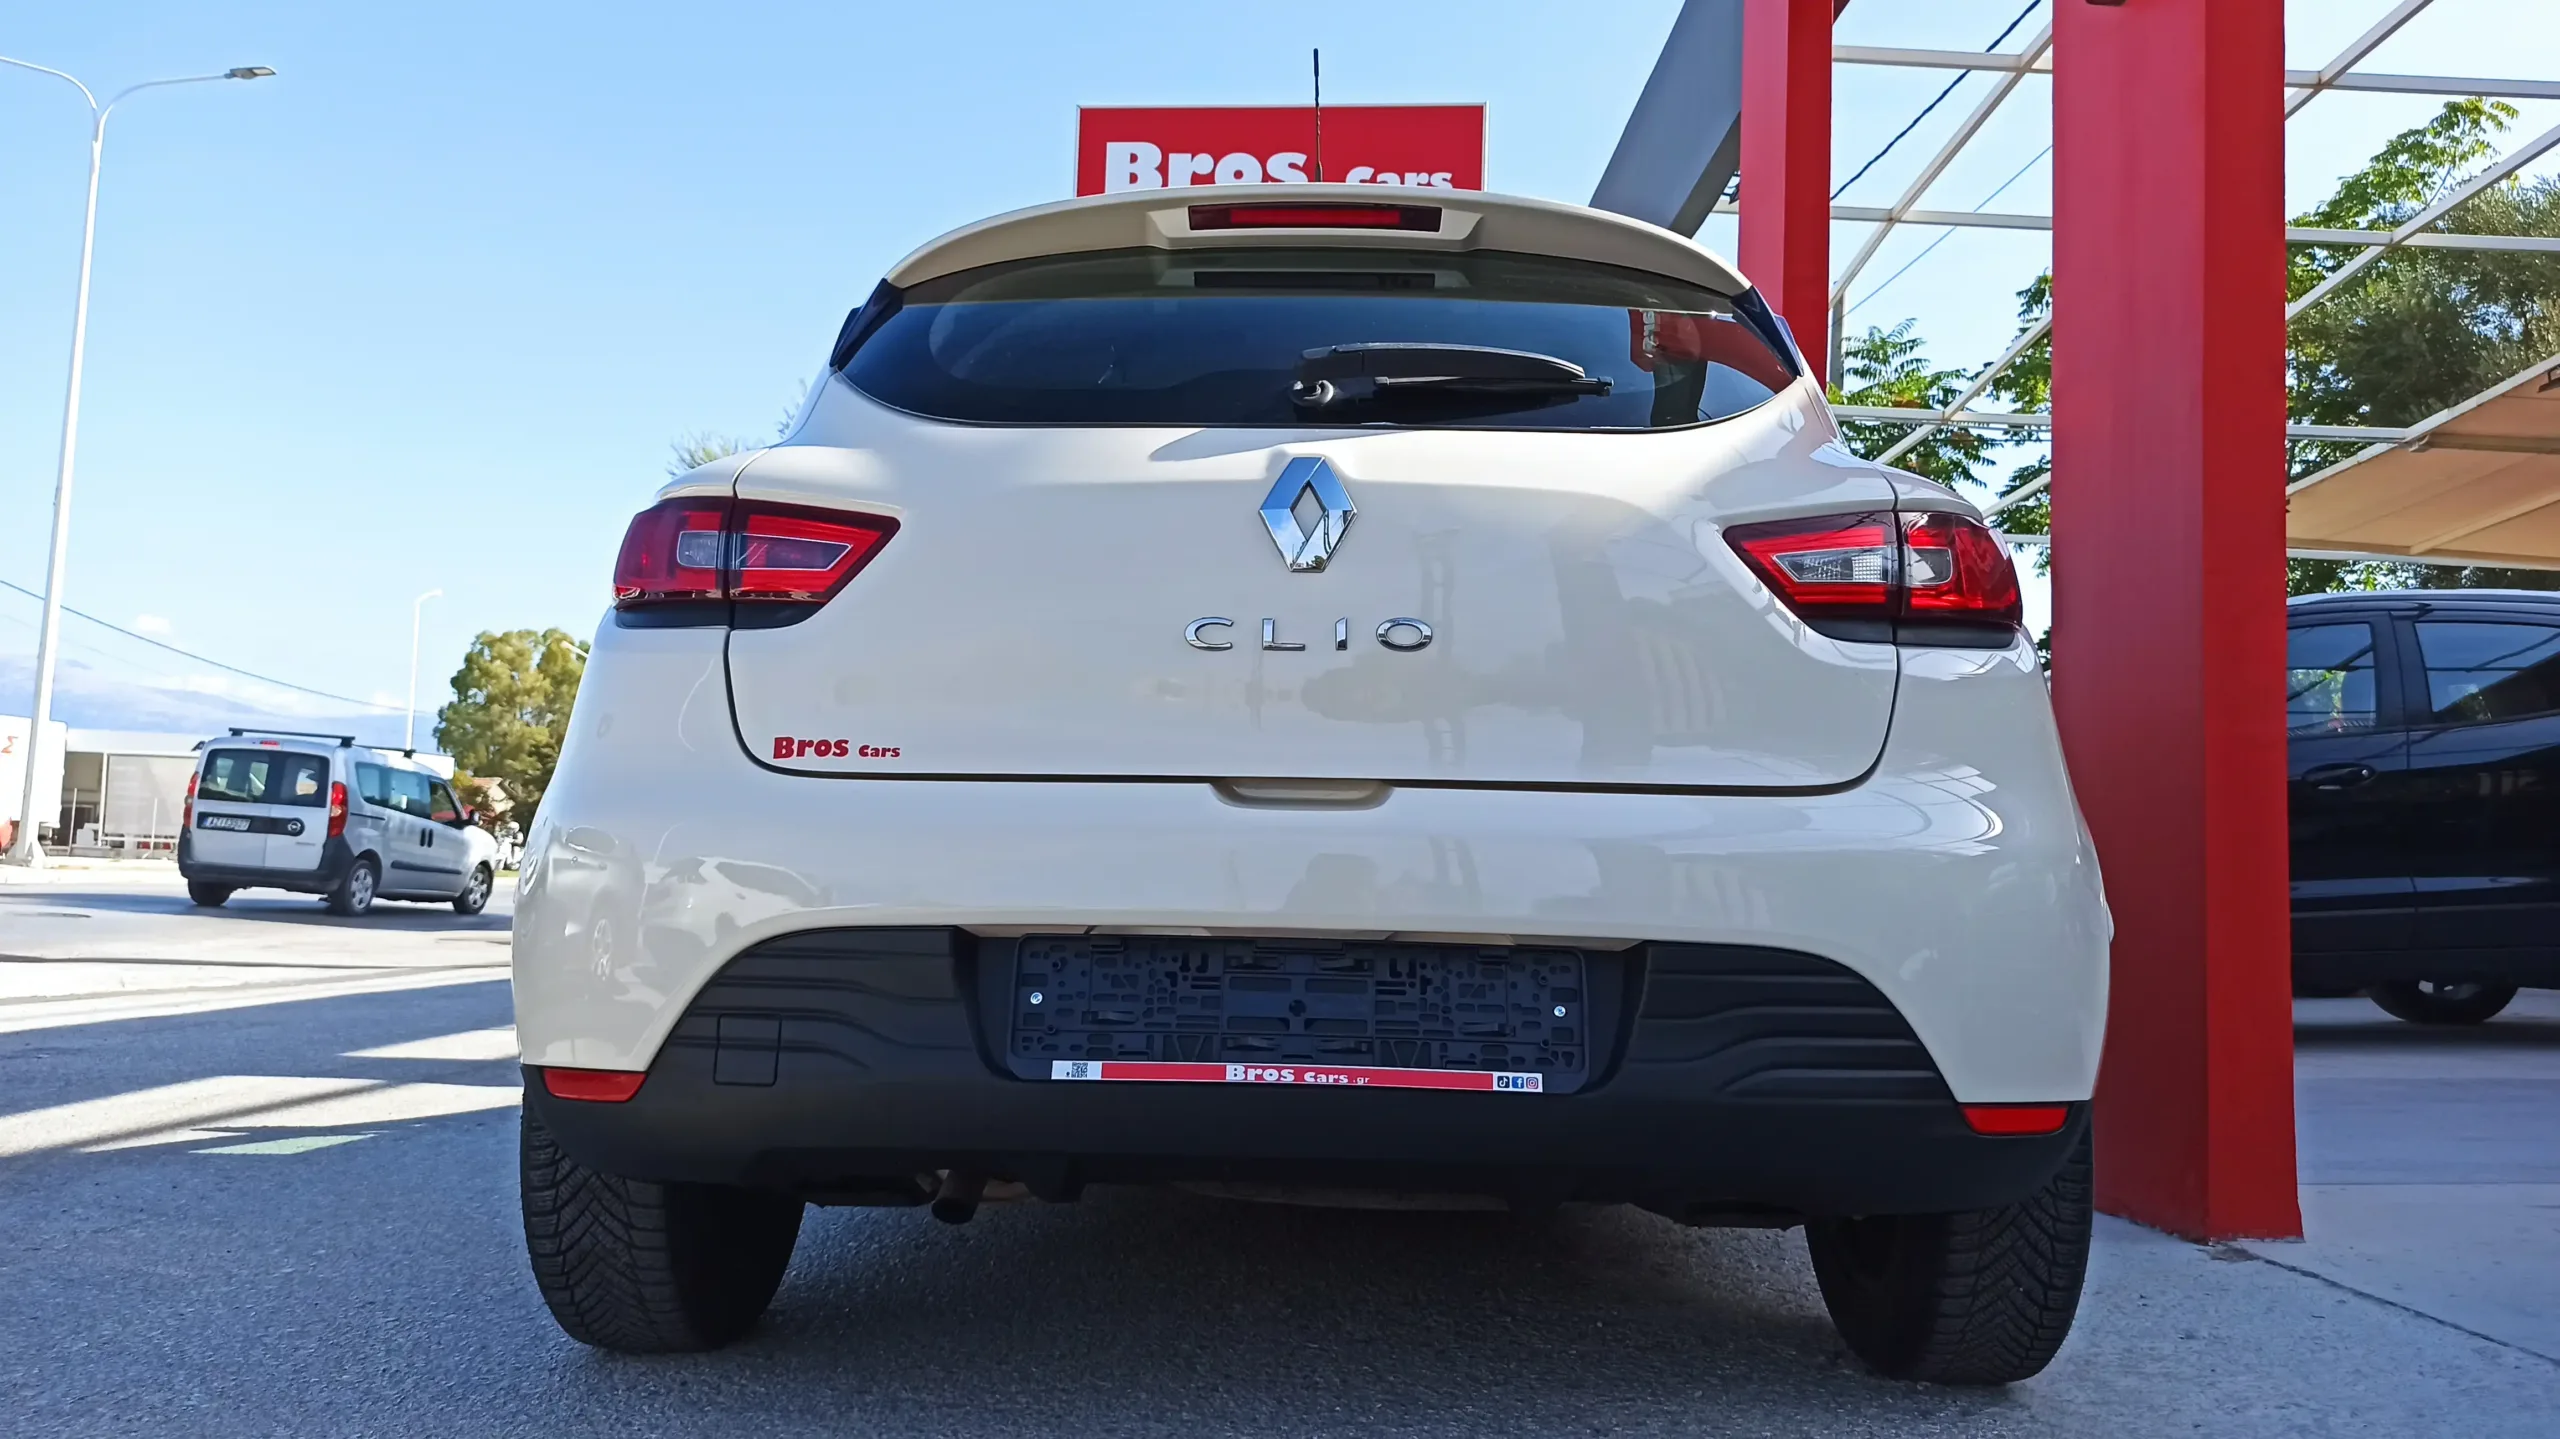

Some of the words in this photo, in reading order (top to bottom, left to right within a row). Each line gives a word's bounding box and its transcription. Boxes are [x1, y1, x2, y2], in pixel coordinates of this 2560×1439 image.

[1105, 141, 1309, 194] Bros
[1184, 616, 1433, 652] CLIO
[773, 736, 850, 759] Bros
[1225, 1064, 1295, 1082] Bros
